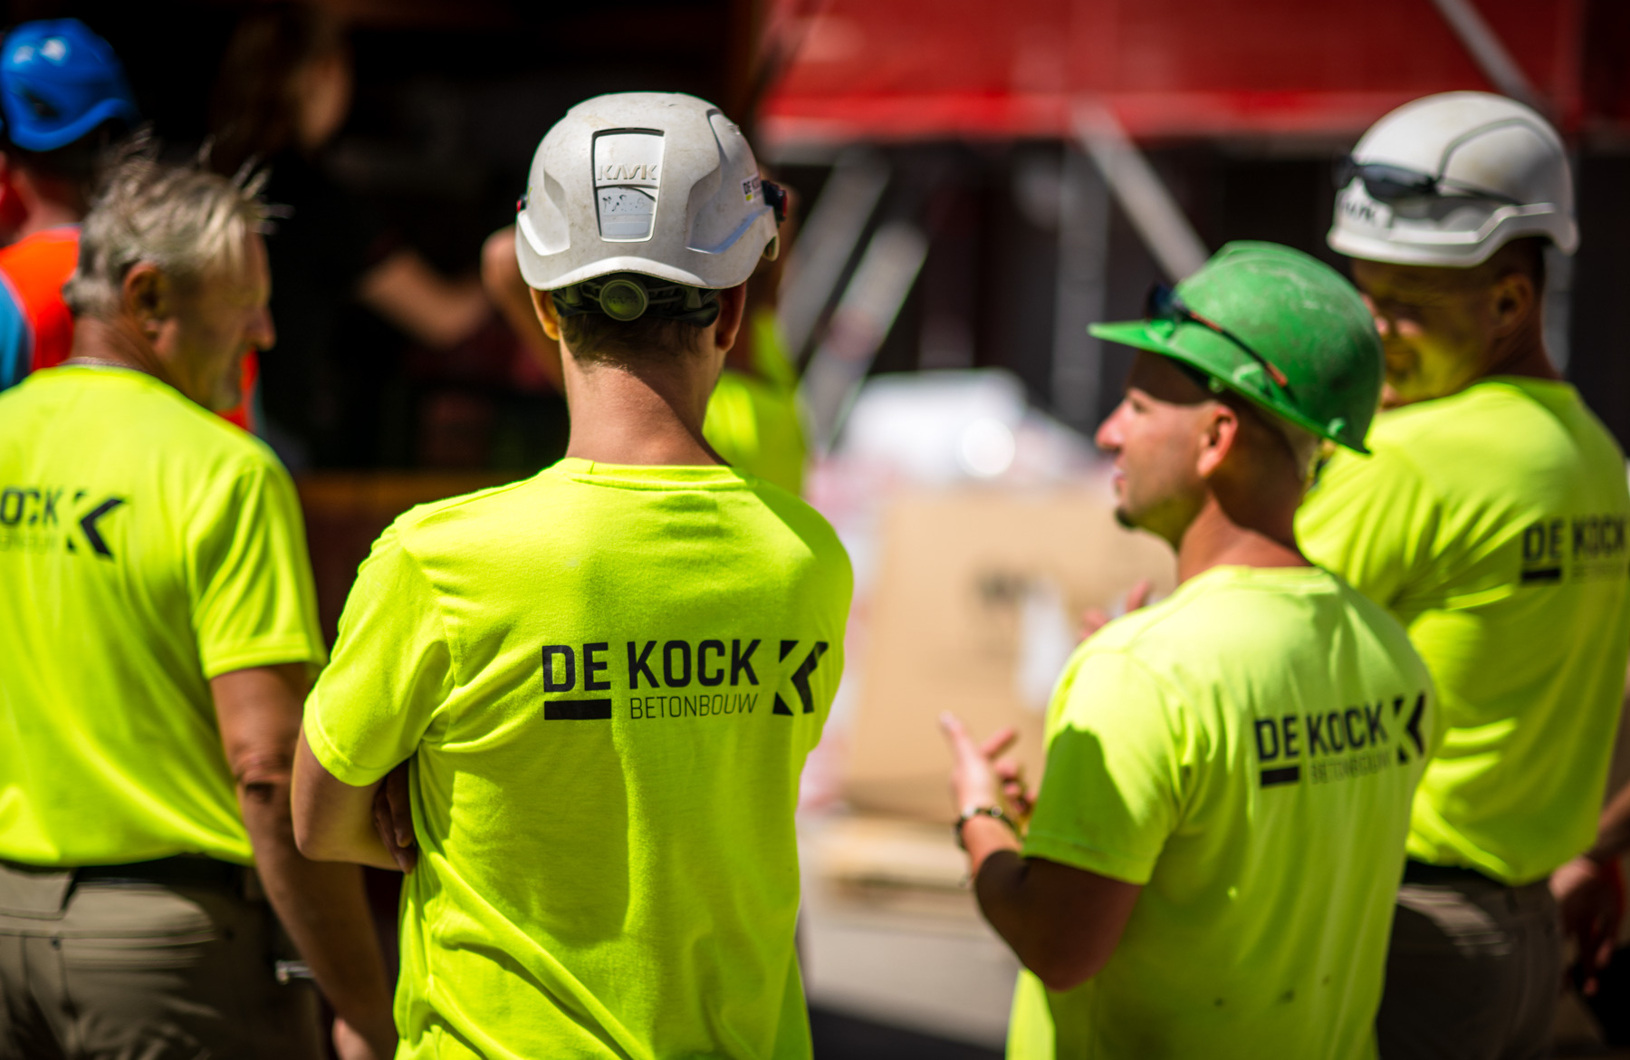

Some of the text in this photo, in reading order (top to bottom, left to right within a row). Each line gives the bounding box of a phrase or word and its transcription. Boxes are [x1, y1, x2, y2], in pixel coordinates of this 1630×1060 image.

[597, 165, 657, 181] KASK
[542, 639, 761, 692] DE KOCK
[630, 693, 758, 719] BETONBOUW
[1254, 702, 1388, 762] DE KOCK
